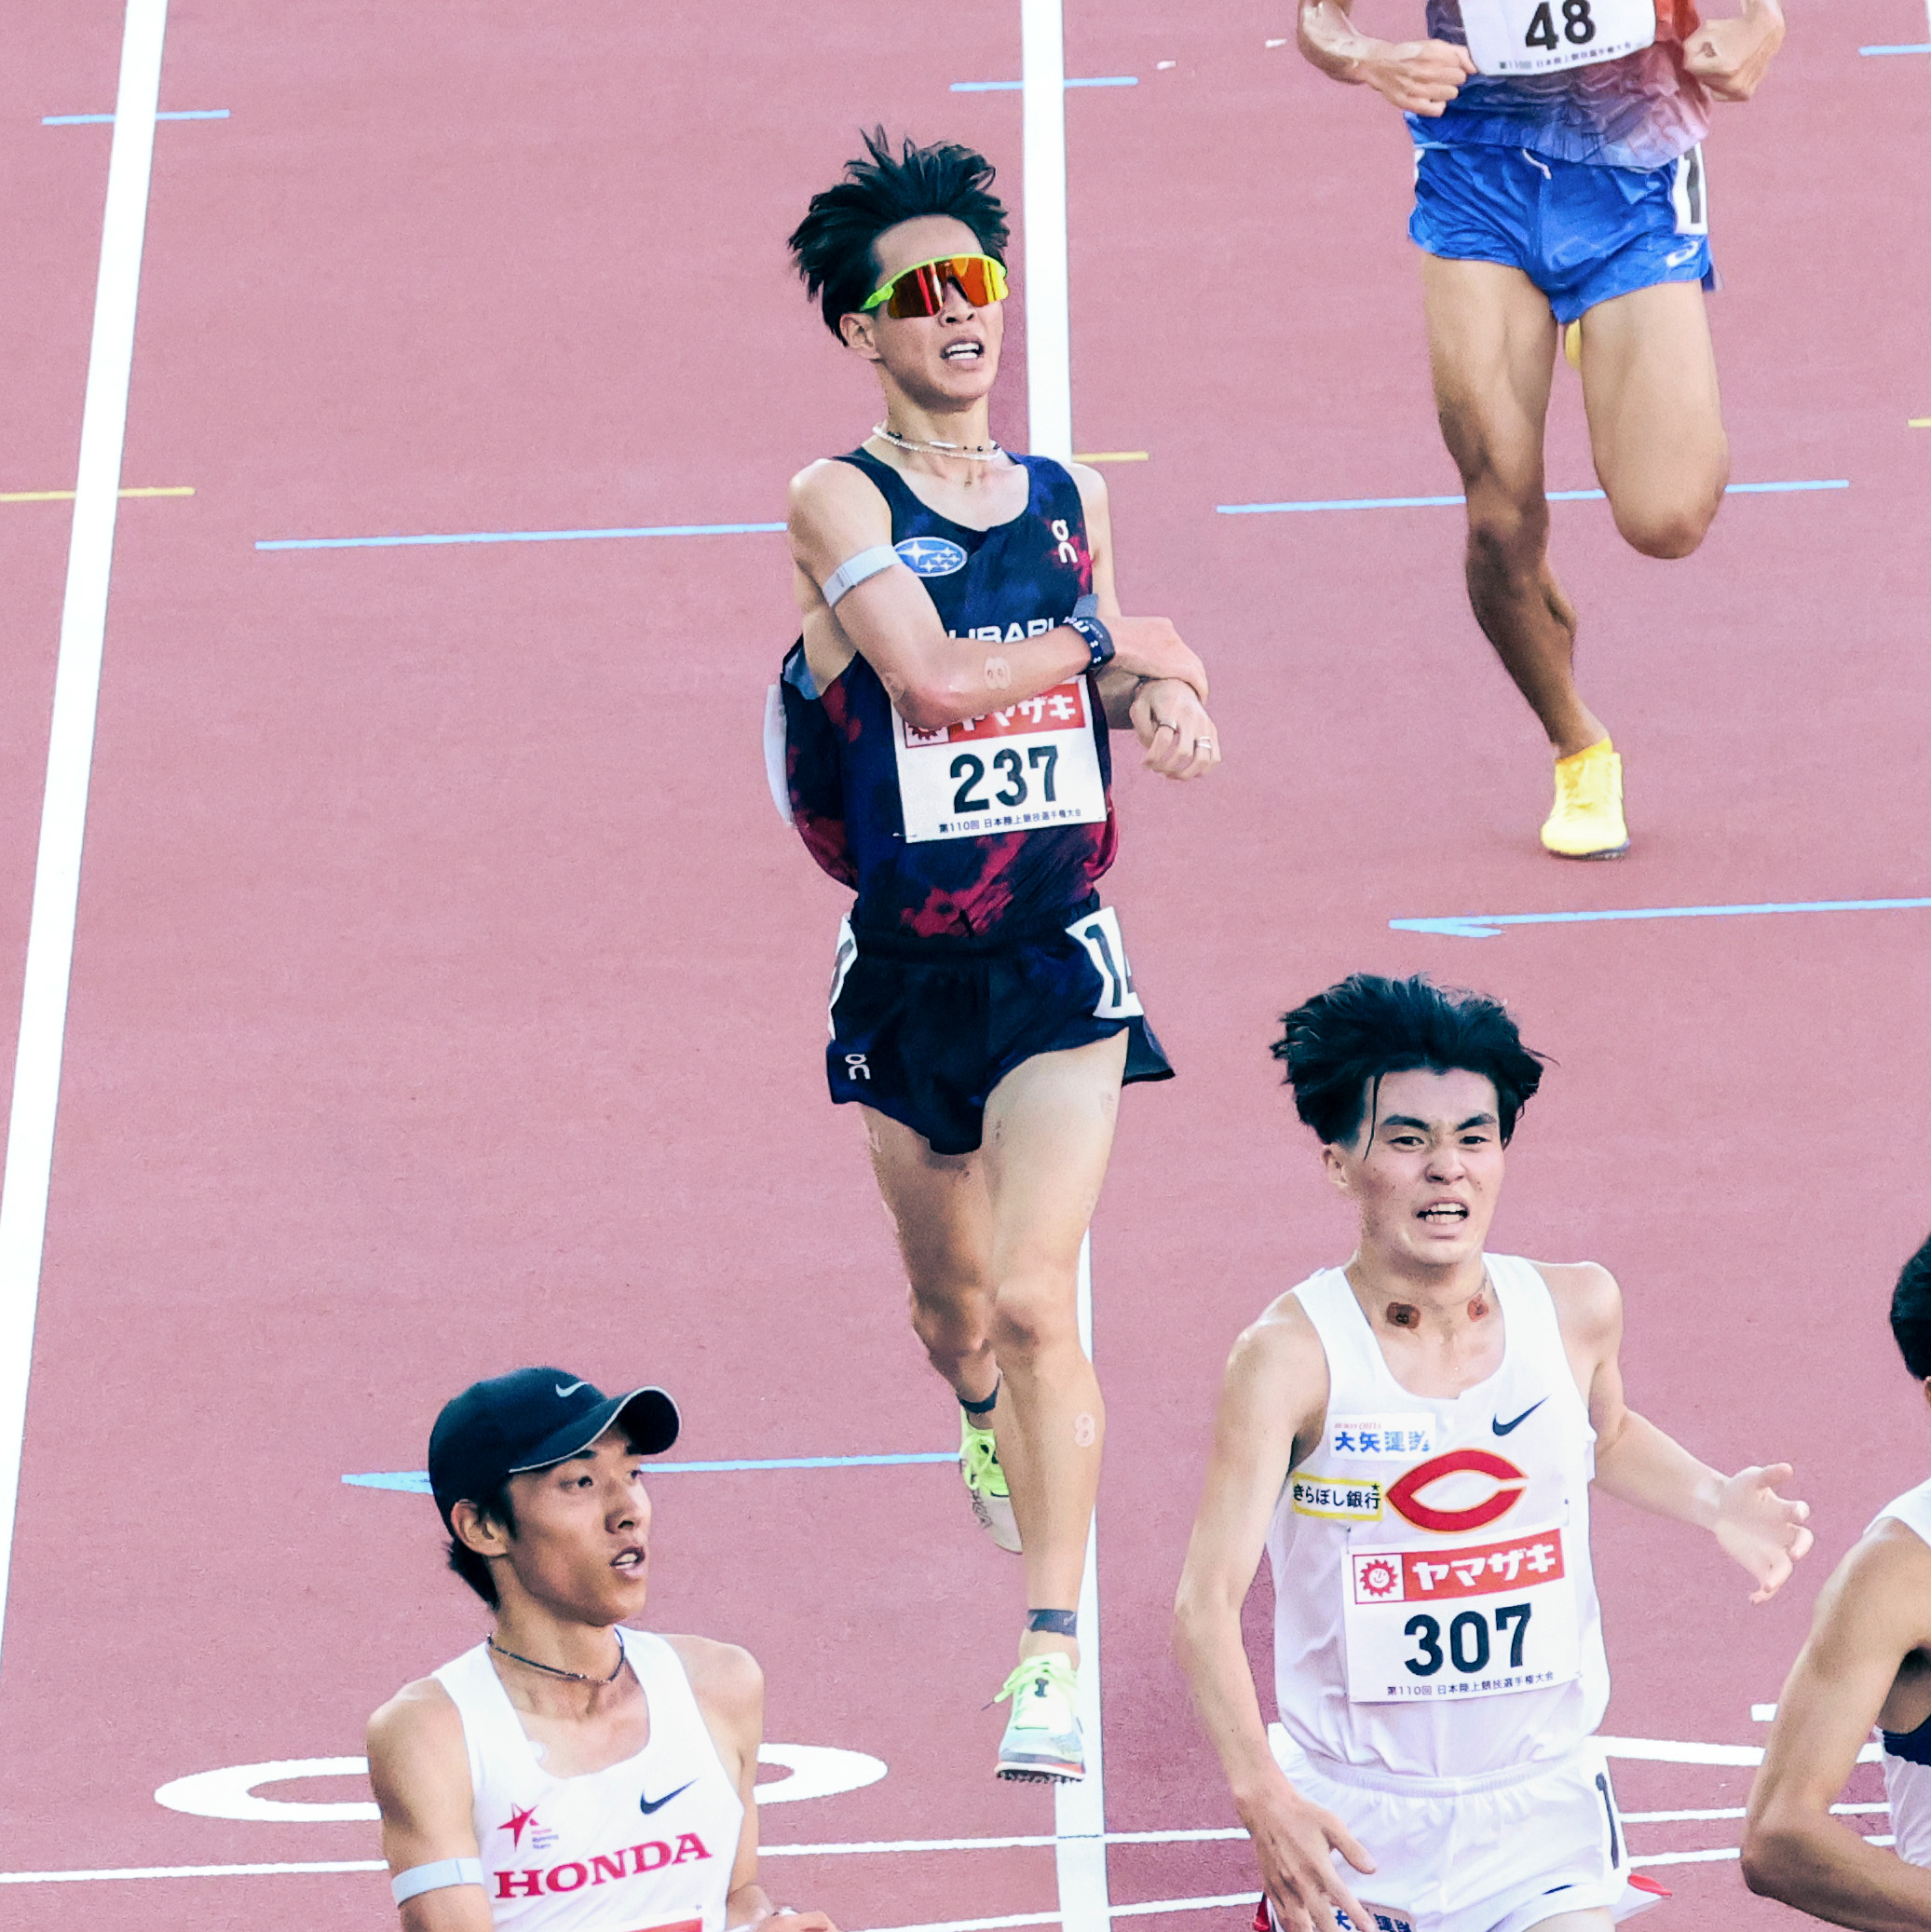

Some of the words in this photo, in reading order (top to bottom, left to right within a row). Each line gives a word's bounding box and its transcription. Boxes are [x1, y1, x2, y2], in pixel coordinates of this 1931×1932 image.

[1525, 0, 1596, 50] 48
[948, 618, 1054, 643] BAR
[950, 744, 1058, 813] 237
[1084, 923, 1136, 1008] 1
[1293, 1483, 1380, 1510] きらぼし銀行
[1412, 1544, 1556, 1591] ヤマザキ
[1404, 1602, 1532, 1677] 307
[493, 1832, 713, 1898] HONDA
